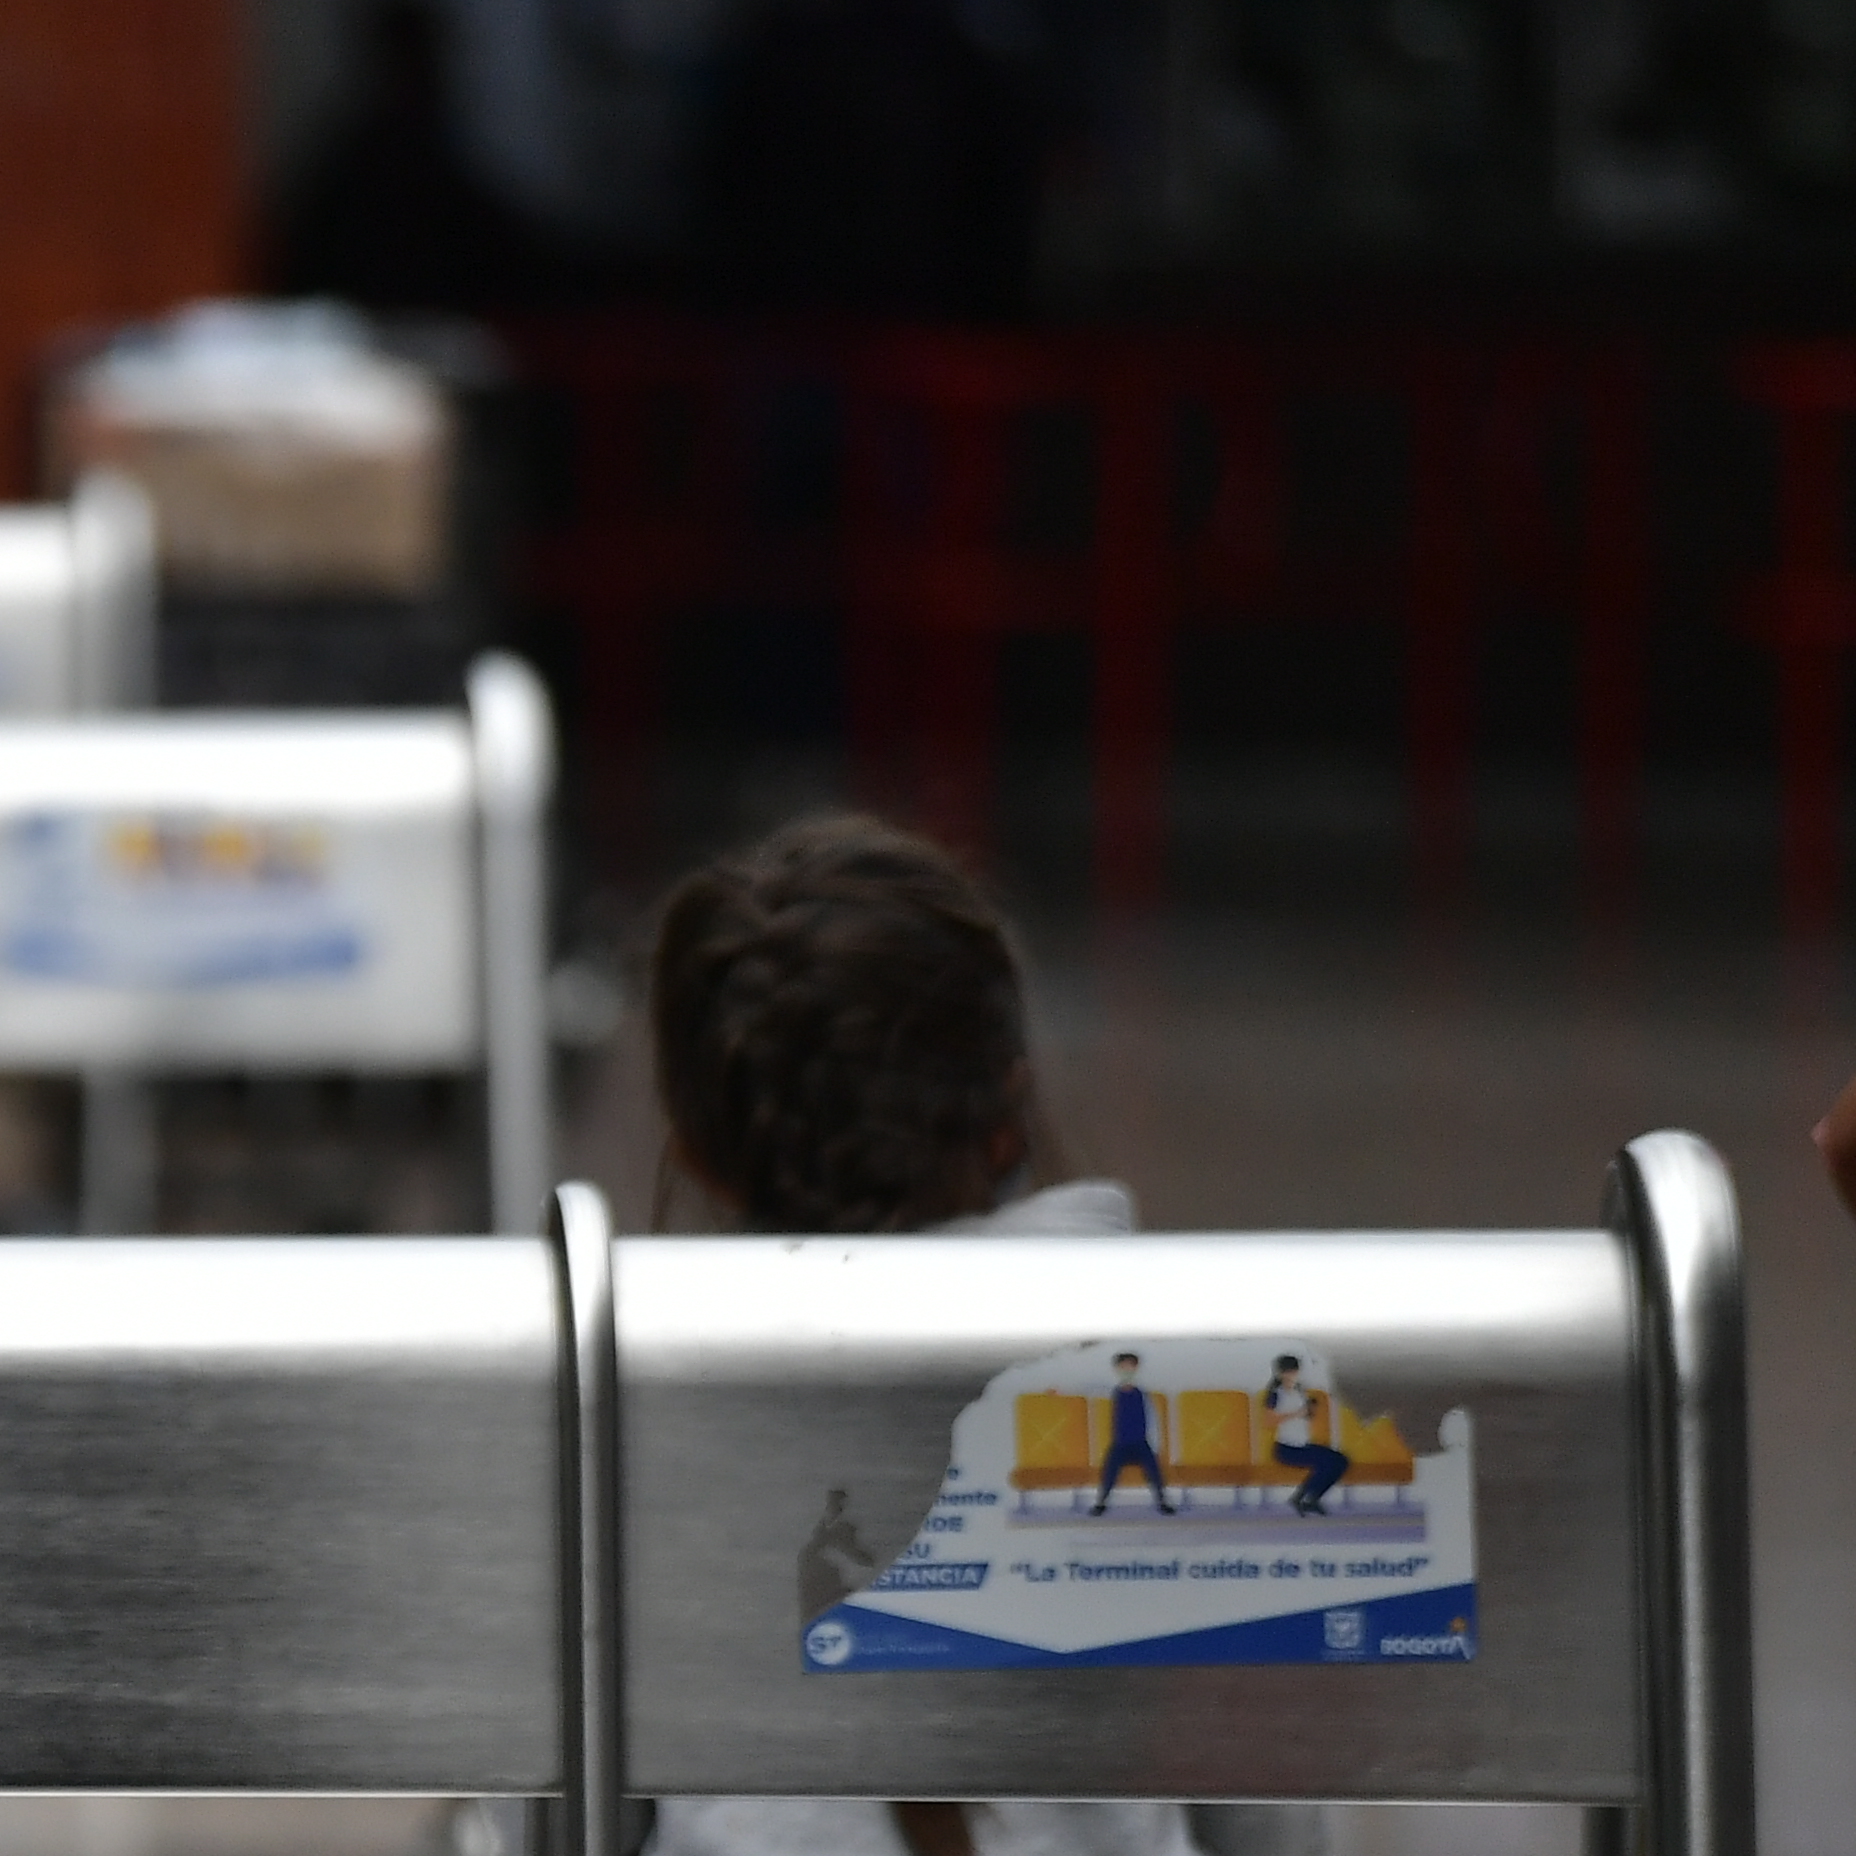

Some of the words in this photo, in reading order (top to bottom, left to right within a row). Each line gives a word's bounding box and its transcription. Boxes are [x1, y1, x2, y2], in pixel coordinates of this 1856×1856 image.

[1063, 1558, 1179, 1581] Terminal
[1188, 1558, 1260, 1580] cuida
[1269, 1557, 1300, 1579] de
[1309, 1558, 1336, 1578] tu
